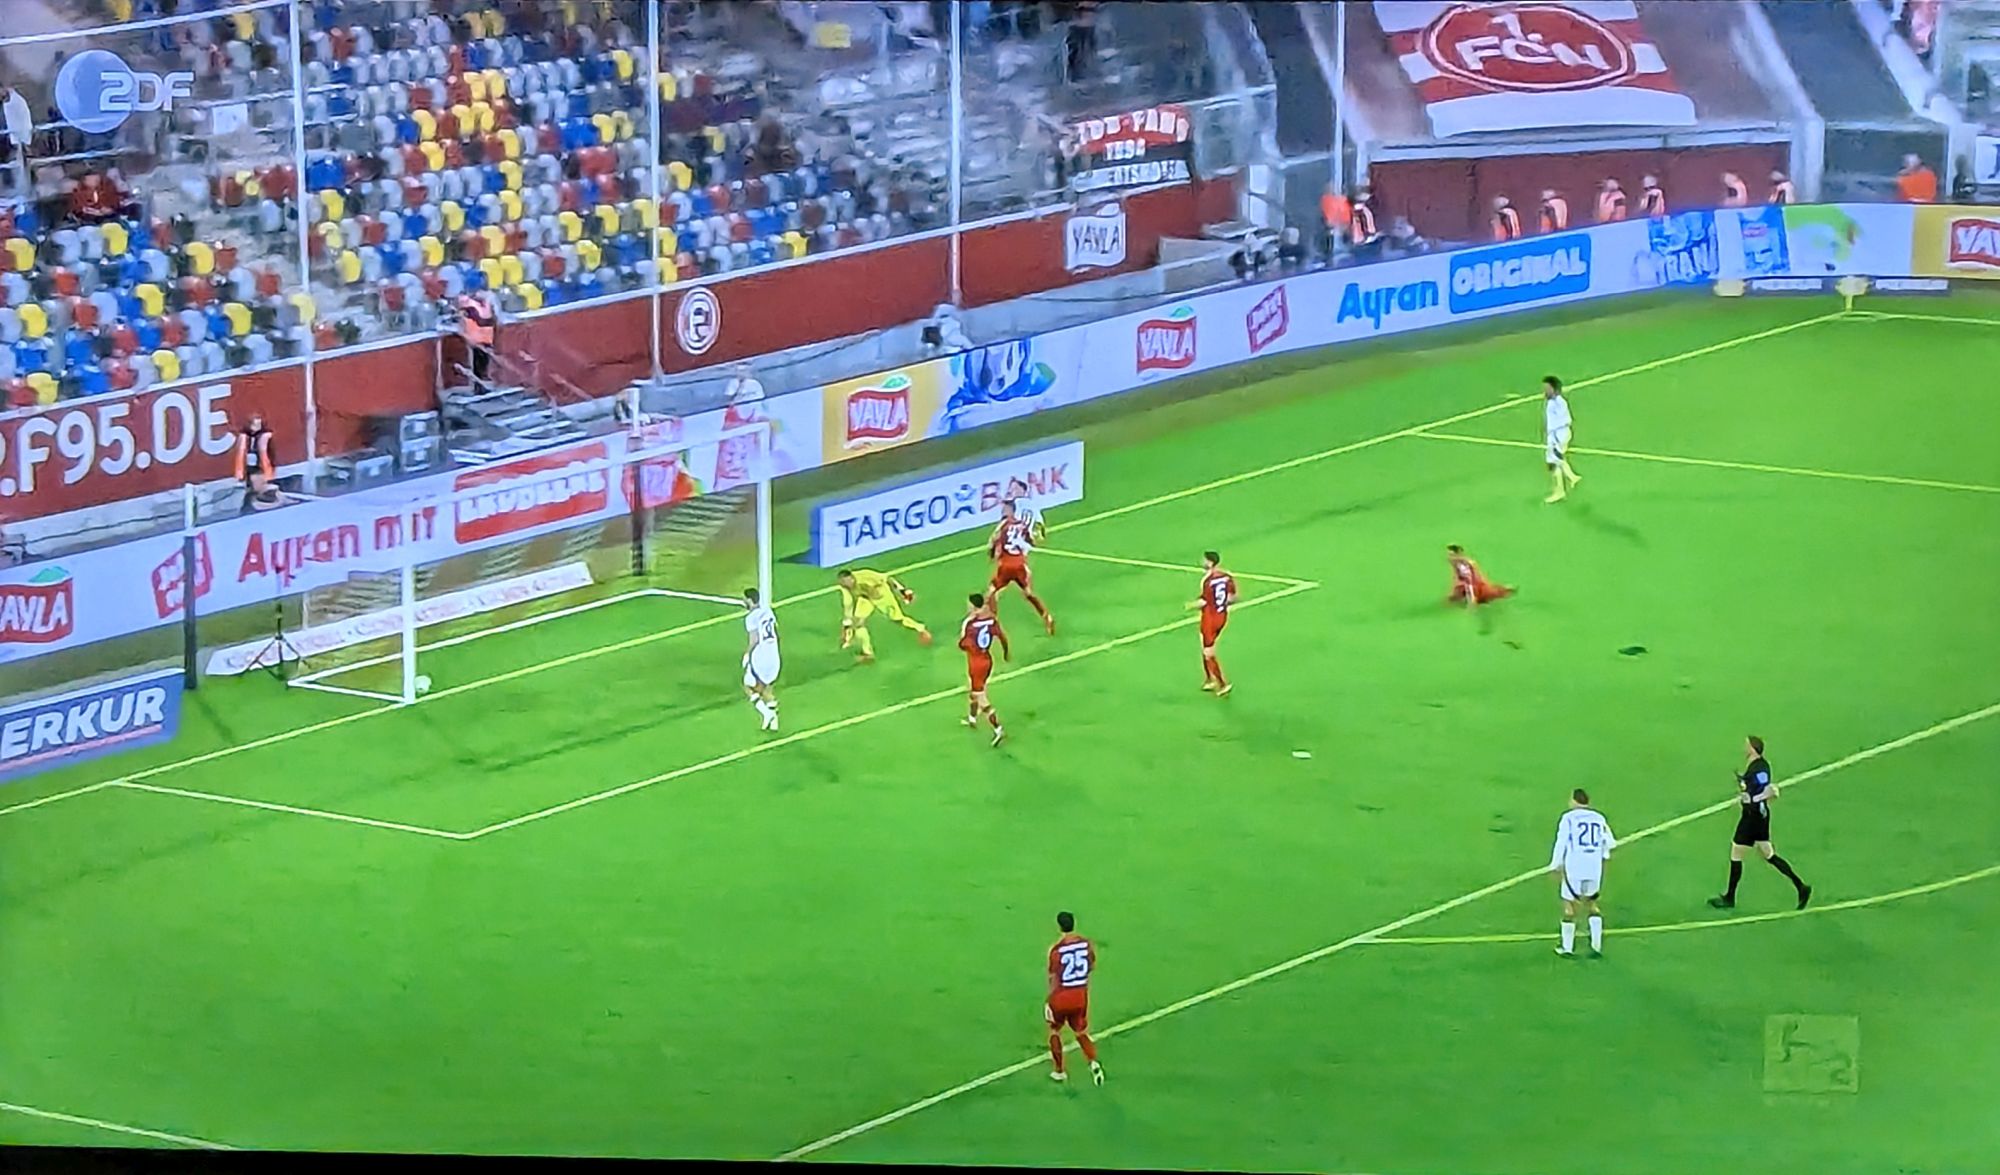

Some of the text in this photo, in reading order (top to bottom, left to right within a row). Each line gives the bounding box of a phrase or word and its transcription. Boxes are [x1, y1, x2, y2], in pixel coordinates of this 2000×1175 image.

[1955, 225, 2000, 256] YA
[1337, 281, 1440, 330] Ayran
[1452, 246, 1588, 297] ORIGINAL
[0, 383, 237, 497] .F95.DE
[236, 522, 361, 588] Ayran
[1214, 582, 1227, 606] 5
[976, 624, 991, 649] 6
[1576, 821, 1602, 848] 20
[1060, 949, 1089, 982] 25
